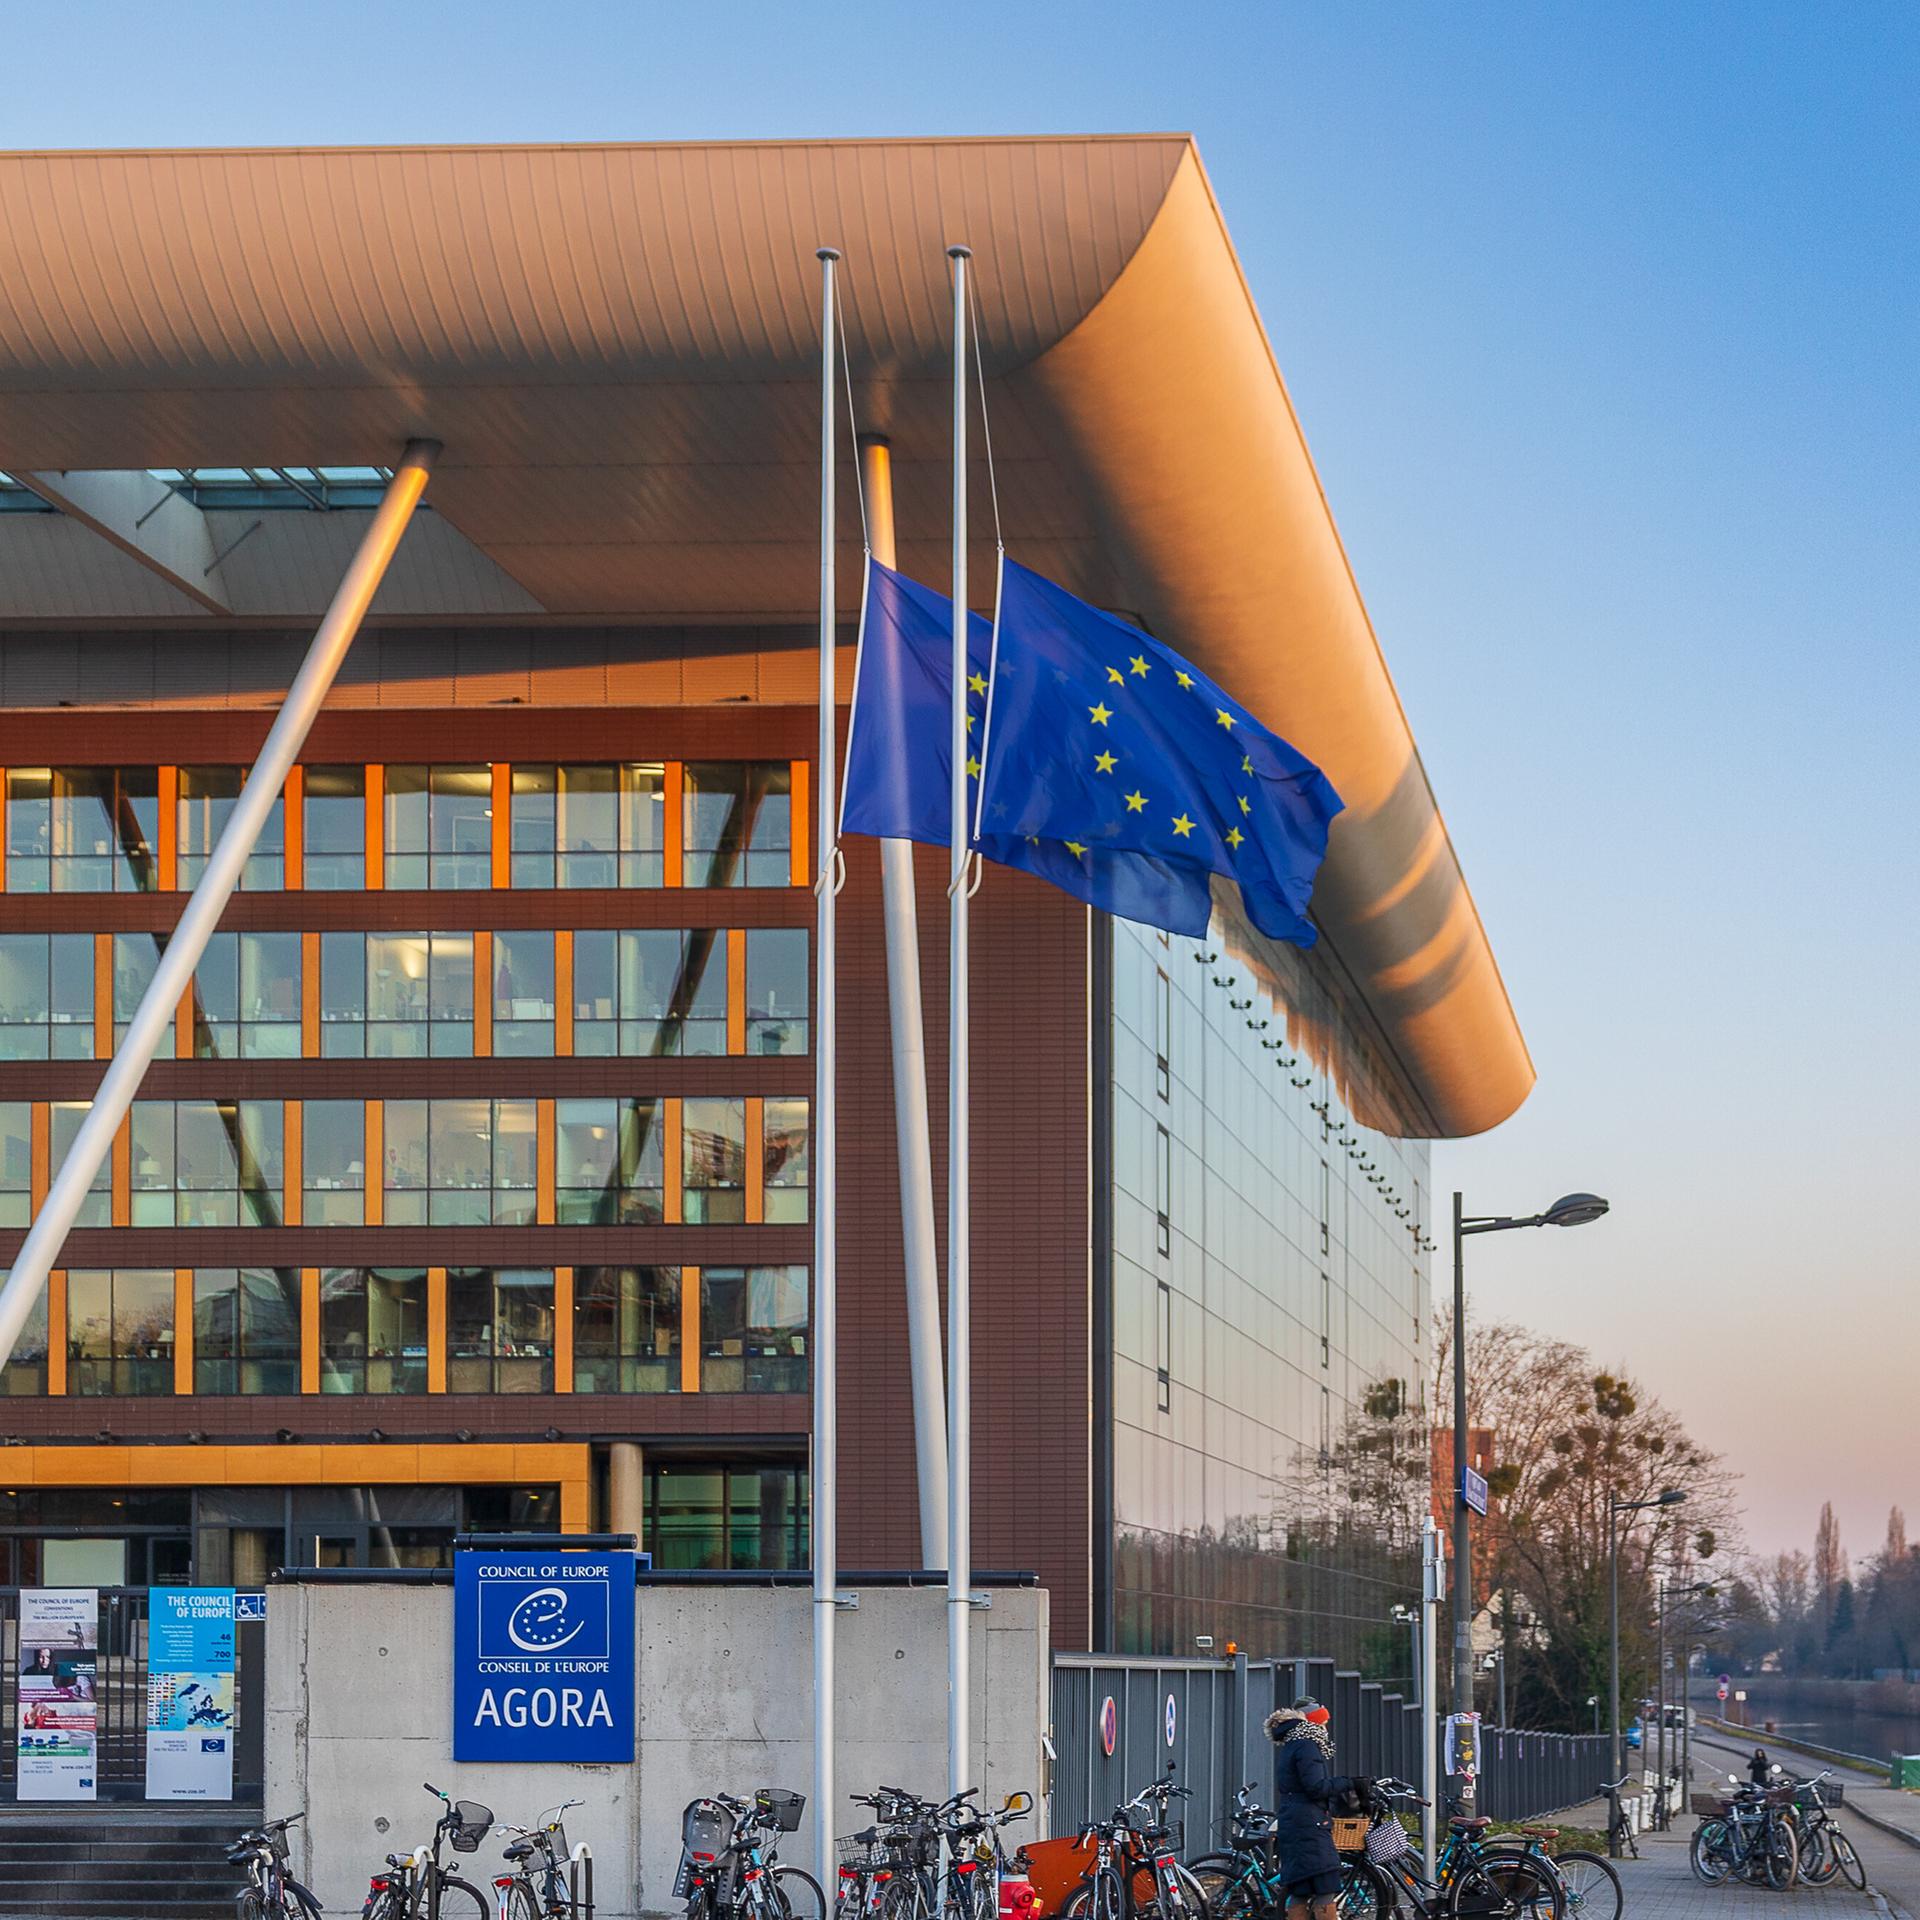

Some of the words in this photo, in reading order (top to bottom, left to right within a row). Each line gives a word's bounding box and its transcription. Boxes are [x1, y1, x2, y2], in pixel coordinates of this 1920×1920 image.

[478, 1566, 537, 1577] COUNCIL
[540, 1566, 558, 1577] OF
[562, 1566, 609, 1577] EUROPE
[167, 1596, 187, 1606] THE
[189, 1596, 231, 1606] COUNCIL
[176, 1608, 189, 1618] OF
[192, 1608, 231, 1618] EUROPE
[478, 1662, 532, 1673] CONSEIL
[535, 1662, 551, 1673] DE
[555, 1662, 609, 1673] L'EUROPE
[473, 1688, 614, 1727] AGORA
